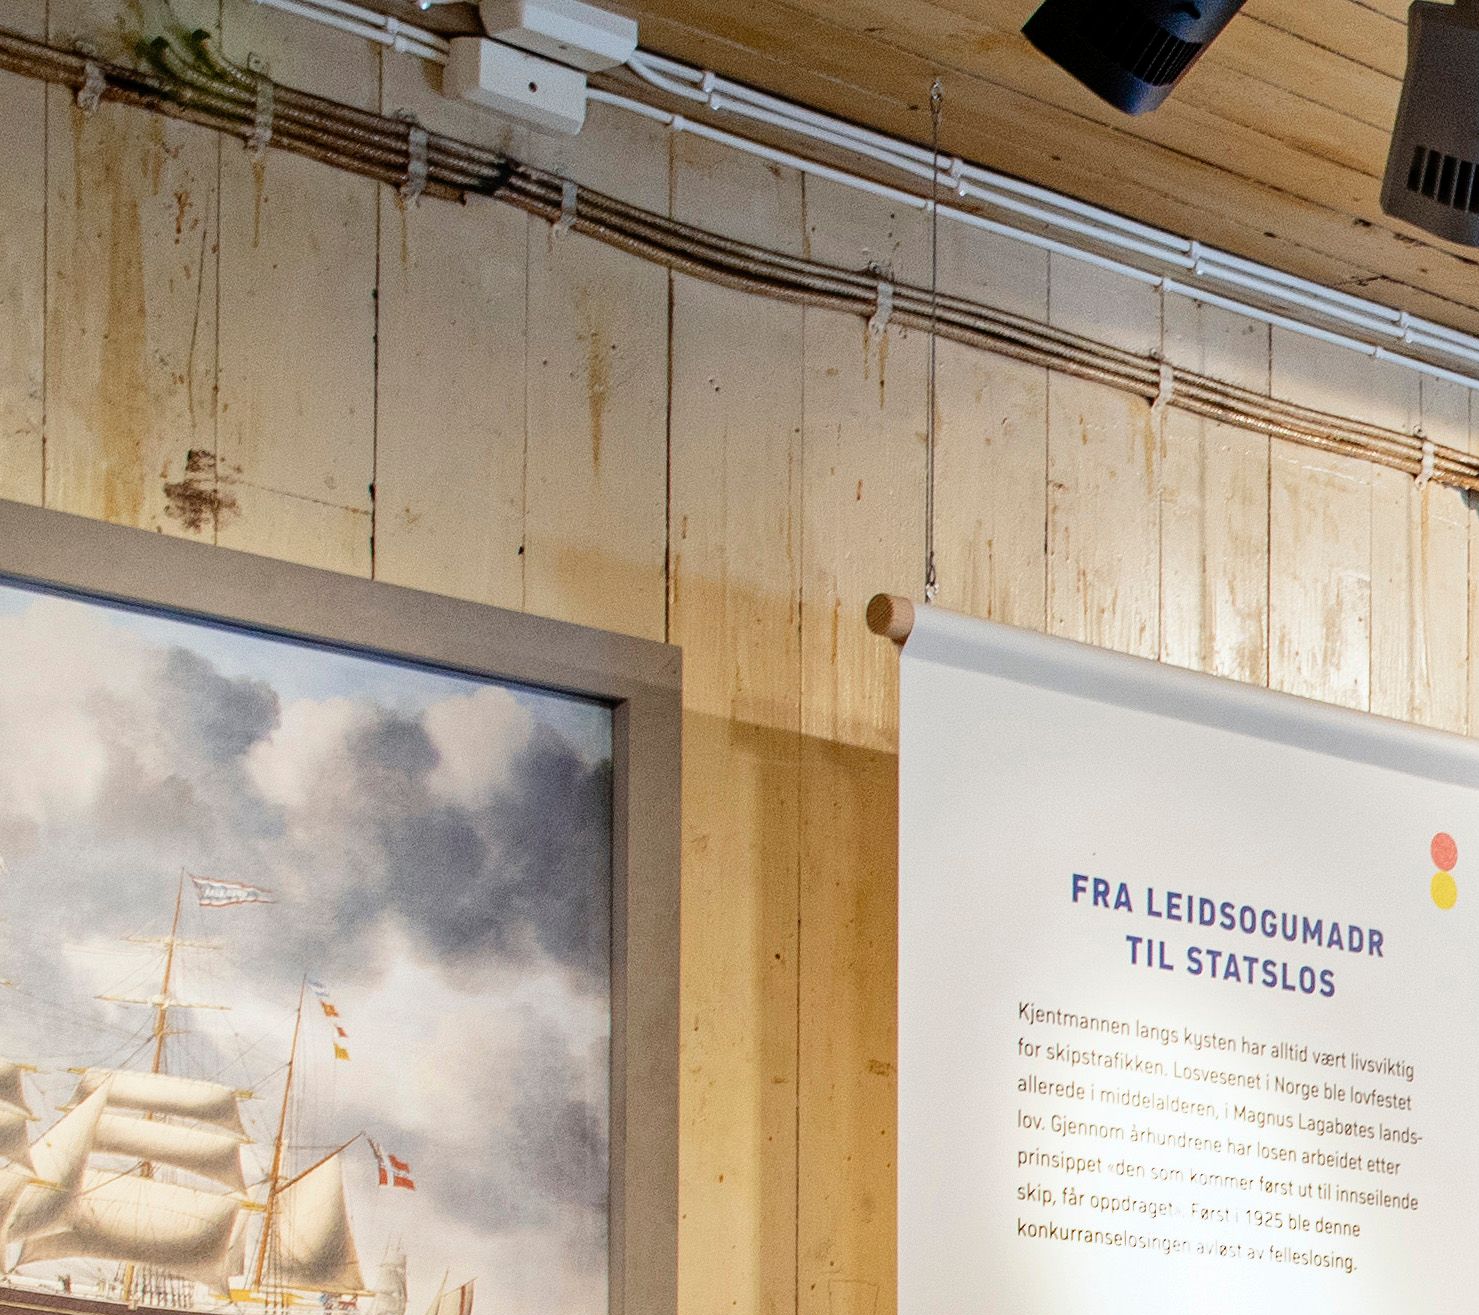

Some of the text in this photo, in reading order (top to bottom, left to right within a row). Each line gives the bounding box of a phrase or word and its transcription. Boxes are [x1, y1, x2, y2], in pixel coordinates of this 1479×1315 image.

[1071, 873, 1384, 955] FRA LEIDSOGUMADR
[1125, 934, 1336, 997] TIL STATSLOS
[1017, 1036, 1041, 1057] for
[1173, 1062, 1261, 1089] Losvesenet
[1274, 1075, 1319, 1101] Norge
[1323, 1081, 1346, 1102] ble
[1350, 1086, 1412, 1111] lovfestet
[1018, 1001, 1414, 1082] Kjentmannen langs kysten har alltid vært livsviktig
[1017, 1074, 1085, 1100] allerede
[1233, 1104, 1294, 1129] Magnus
[1298, 1113, 1375, 1139] Lagabøtes
[1379, 1122, 1423, 1145] lands-
[1017, 1108, 1401, 1175] lov. Gjennom århundrene har losen arbeidet etter
[1017, 1148, 1102, 1172] prinsippet
[1151, 1166, 1184, 1182] som
[1190, 1167, 1253, 1191] kommer
[1260, 1176, 1293, 1196] først
[1298, 1184, 1312, 1198] ut
[1318, 1184, 1331, 1200] til
[1336, 1186, 1418, 1210] innseilende
[1017, 1182, 1057, 1206] skip,
[1062, 1186, 1084, 1206] får
[1246, 1208, 1284, 1229] 1925
[1287, 1213, 1311, 1232] ble
[1315, 1217, 1362, 1237] denne
[1017, 1218, 1357, 1274] konkurranselosingen avløst av felleslosing.
